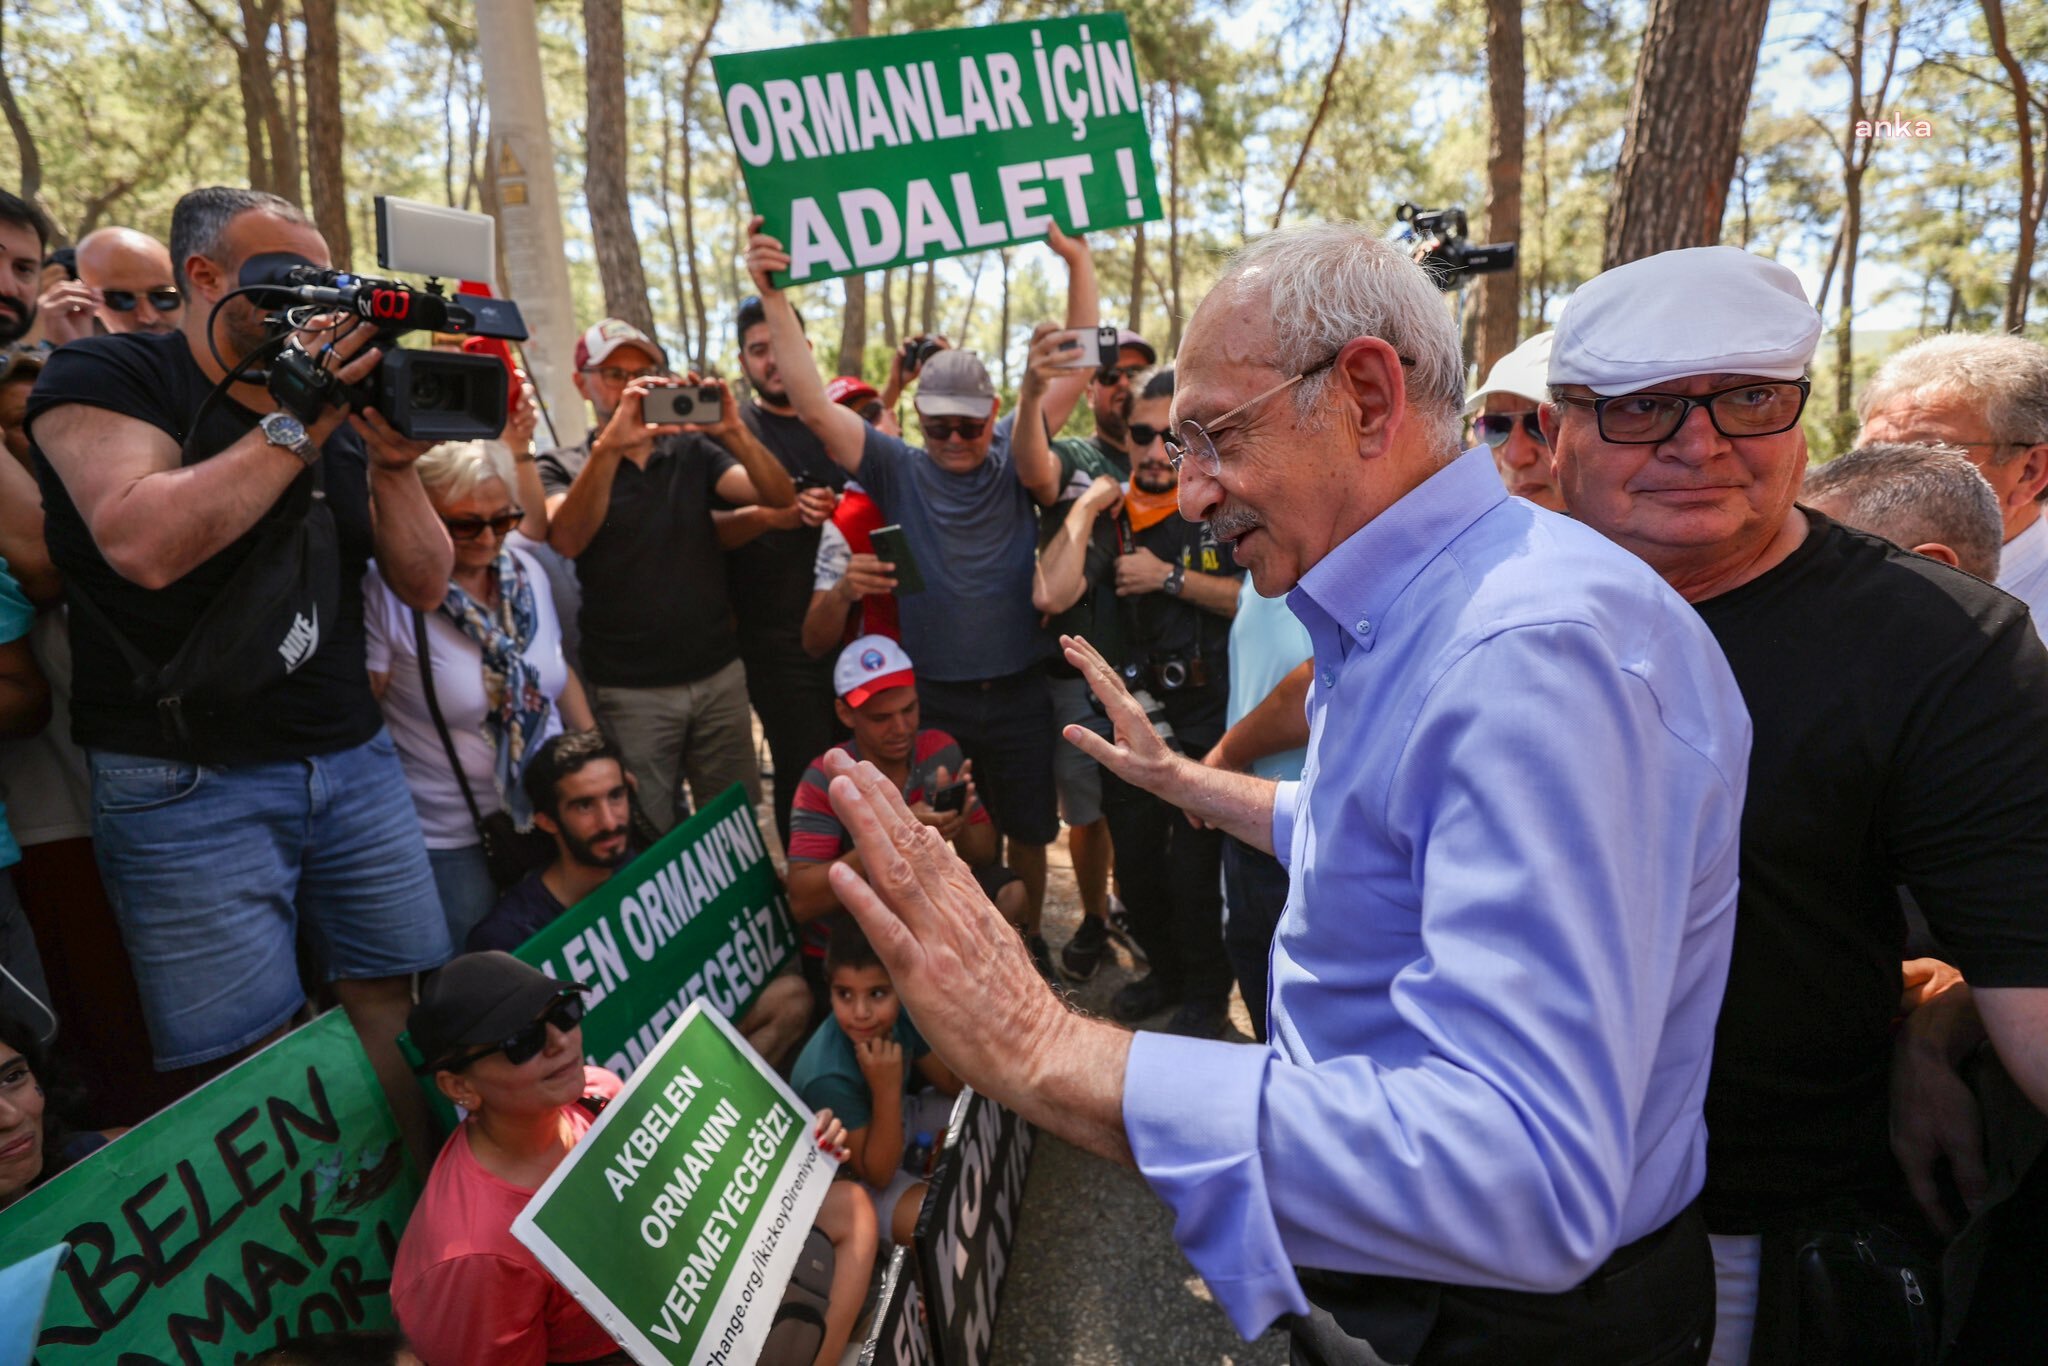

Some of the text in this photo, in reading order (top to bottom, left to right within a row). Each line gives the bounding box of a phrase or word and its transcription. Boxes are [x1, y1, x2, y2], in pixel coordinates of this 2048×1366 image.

[727, 24, 1139, 167] ORMANLAR İÇİN
[790, 153, 1094, 280] ADALET
[278, 611, 312, 665] NIKE
[604, 1065, 704, 1202] AKBELEN
[640, 1097, 742, 1249] ORMANINI
[117, 1170, 360, 1366] MAK
[650, 1102, 793, 1345] VERMEYECEĞİZ!
